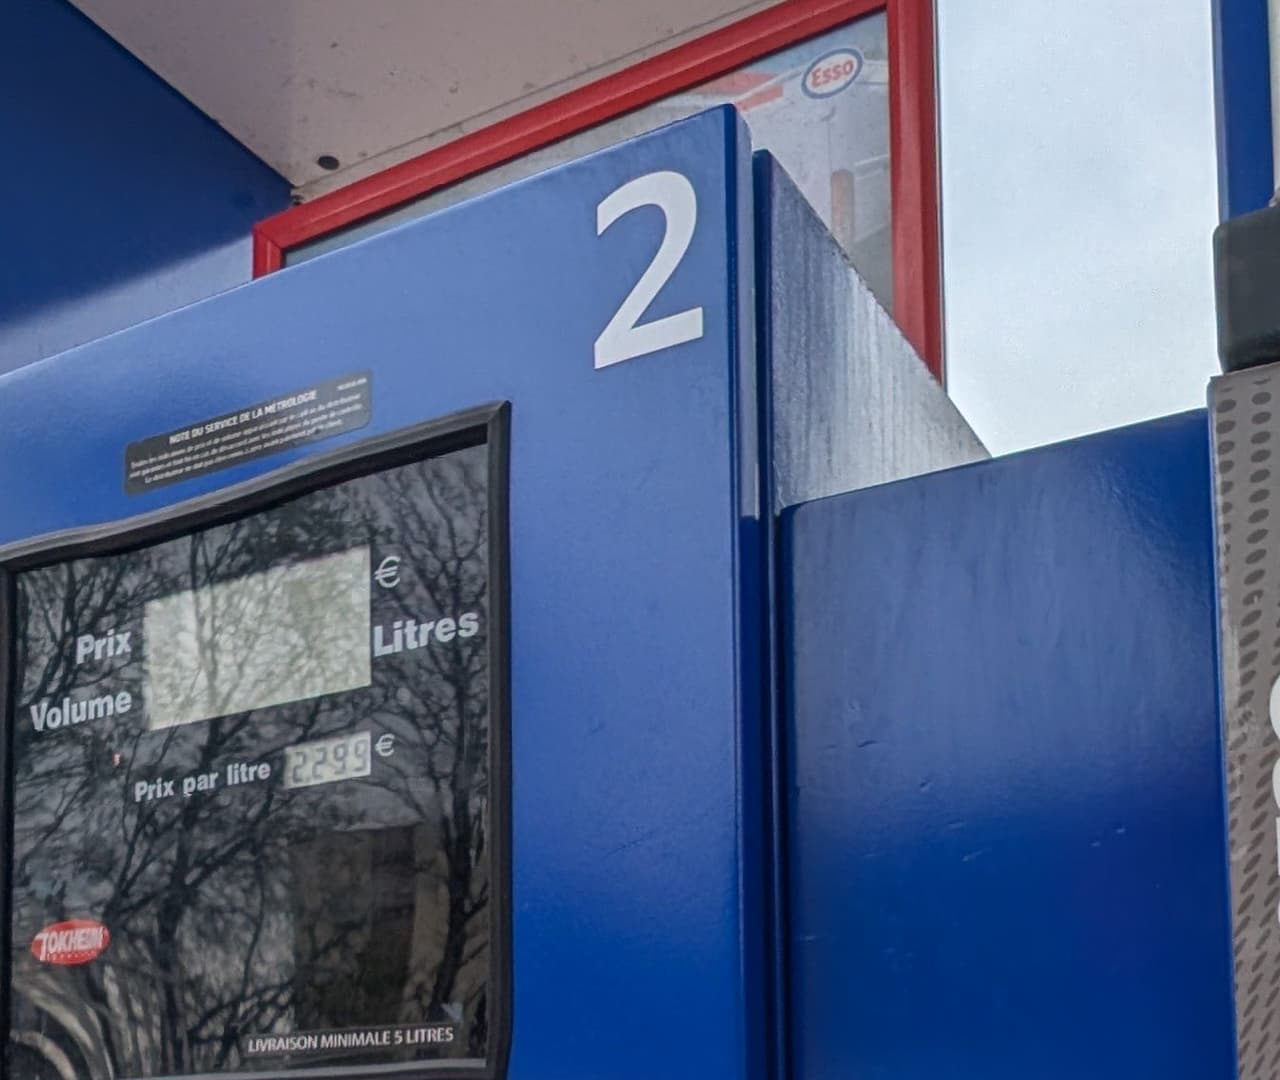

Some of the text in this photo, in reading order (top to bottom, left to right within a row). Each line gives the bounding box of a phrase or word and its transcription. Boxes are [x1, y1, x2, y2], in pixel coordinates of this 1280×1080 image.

[808, 56, 855, 90] Esso
[593, 169, 704, 370] 2
[76, 556, 401, 665] Prix €
[31, 611, 479, 732] Volume Litres
[375, 734, 396, 757] €
[134, 758, 271, 802] Prix par litre
[248, 1026, 454, 1053] LIVRAISON MINIMALE 5 LITRES
